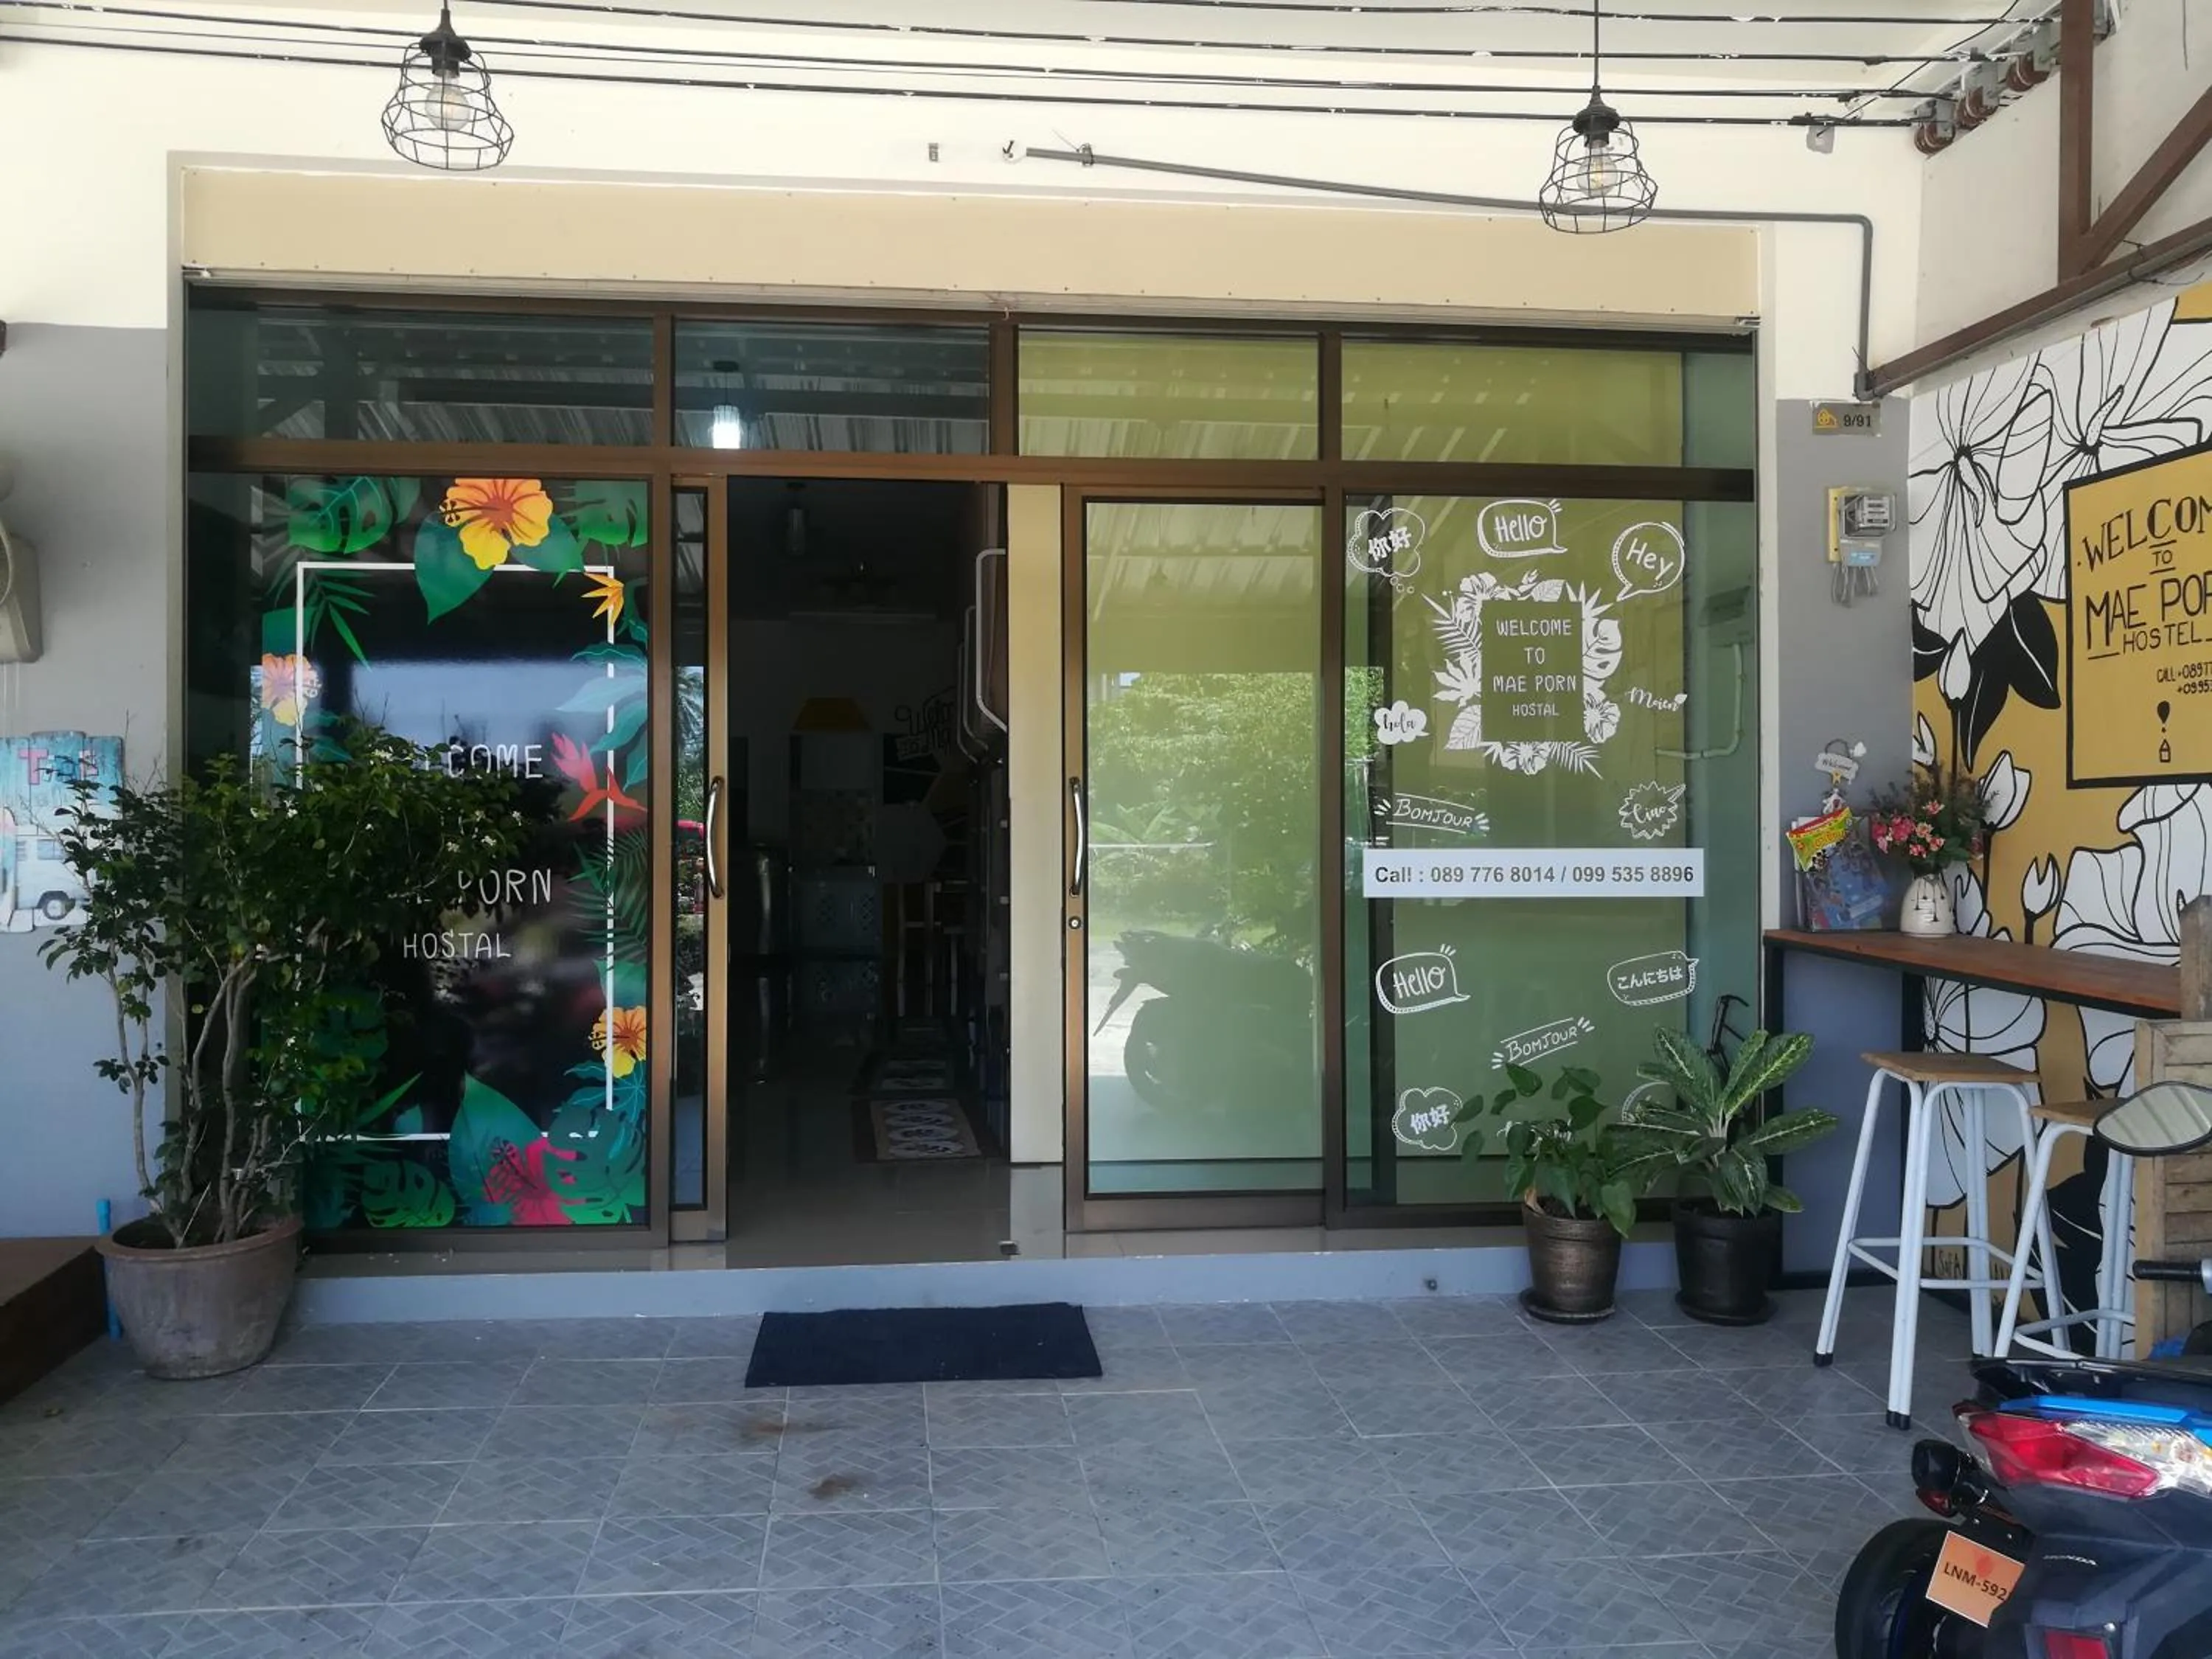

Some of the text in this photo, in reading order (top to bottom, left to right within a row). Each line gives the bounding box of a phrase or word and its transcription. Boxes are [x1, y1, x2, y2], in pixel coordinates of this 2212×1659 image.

[1494, 514, 1548, 543] Hello
[1368, 526, 1412, 562] 你好
[2151, 549, 2173, 567] TO
[1625, 537, 1674, 582] Hey
[1495, 619, 1573, 637] WELCOME
[2085, 583, 2147, 650] MAE
[2123, 621, 2202, 655] HOSTEL
[1523, 647, 1545, 665] TO
[1493, 675, 1576, 693] MAE PORN
[1512, 703, 1560, 717] HOSTAL
[424, 744, 544, 780] COME
[1633, 802, 1667, 824] Ciao
[1430, 866, 1464, 883] 089
[1470, 866, 1503, 883] 776
[1510, 866, 1555, 883] 8014
[1572, 866, 1605, 883] 099
[1611, 866, 1644, 883] 535
[1650, 866, 1694, 883] 8896
[403, 930, 512, 959] HOSTAL
[1392, 966, 1447, 998] Hello
[1616, 965, 1683, 990] こんにちは
[1409, 1103, 1451, 1135] 你好
[1943, 1561, 2008, 1601] LNM-592
